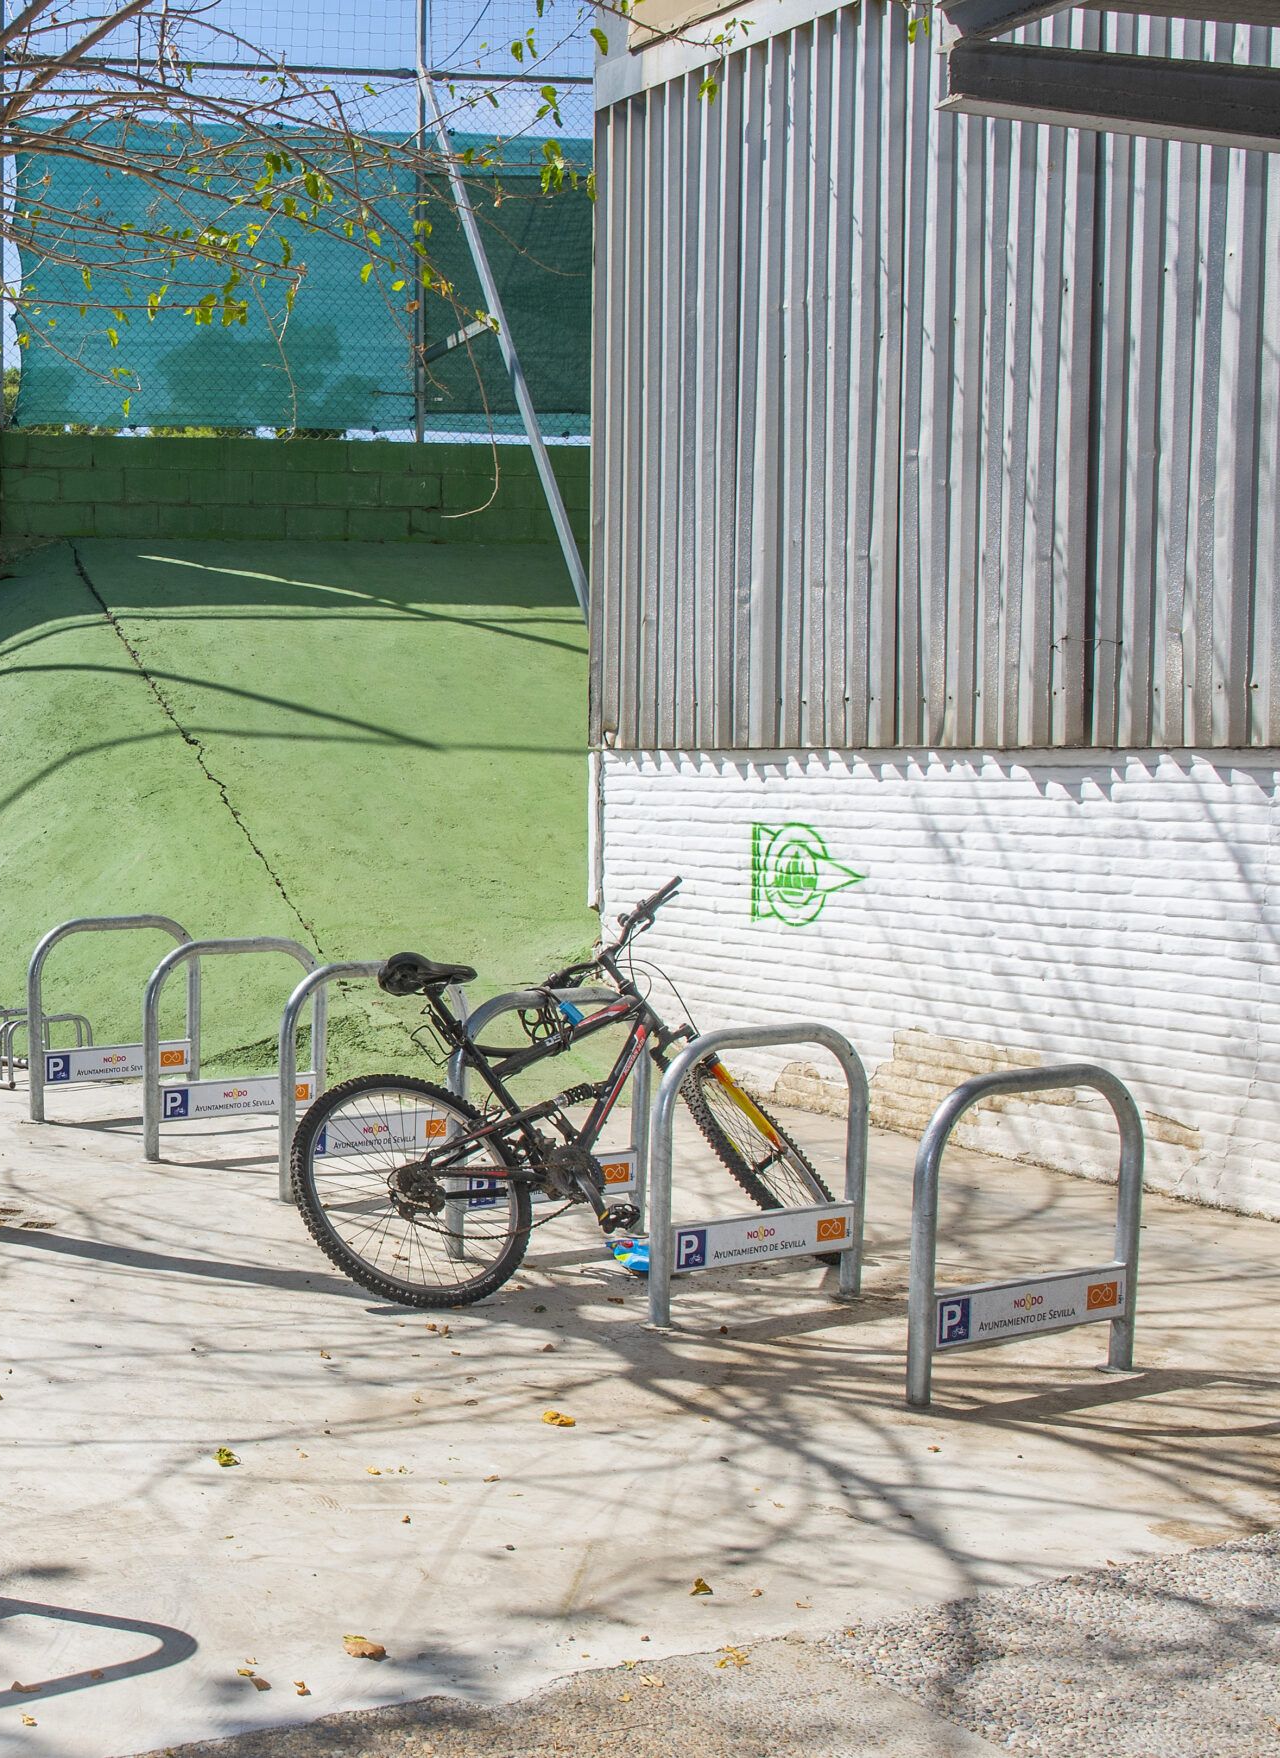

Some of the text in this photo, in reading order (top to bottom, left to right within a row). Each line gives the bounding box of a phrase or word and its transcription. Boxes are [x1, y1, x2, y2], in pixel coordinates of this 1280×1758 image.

[49, 1058, 64, 1080] P
[77, 1067, 121, 1076] AYUNTAMIENTO
[166, 1092, 182, 1116] P
[195, 1103, 241, 1113] AYUNTAMIENTO
[252, 1099, 275, 1107] SEVILLA
[333, 1139, 382, 1149] AYUNTAMIENTO
[393, 1135, 416, 1143] SEVILLA
[679, 1234, 699, 1265] P
[713, 1239, 807, 1260] AYUNTAMIENTO DE SEVILLA
[942, 1304, 962, 1339] P
[978, 1308, 1076, 1332] AYUNTAMIENTO DE SEVILLA
